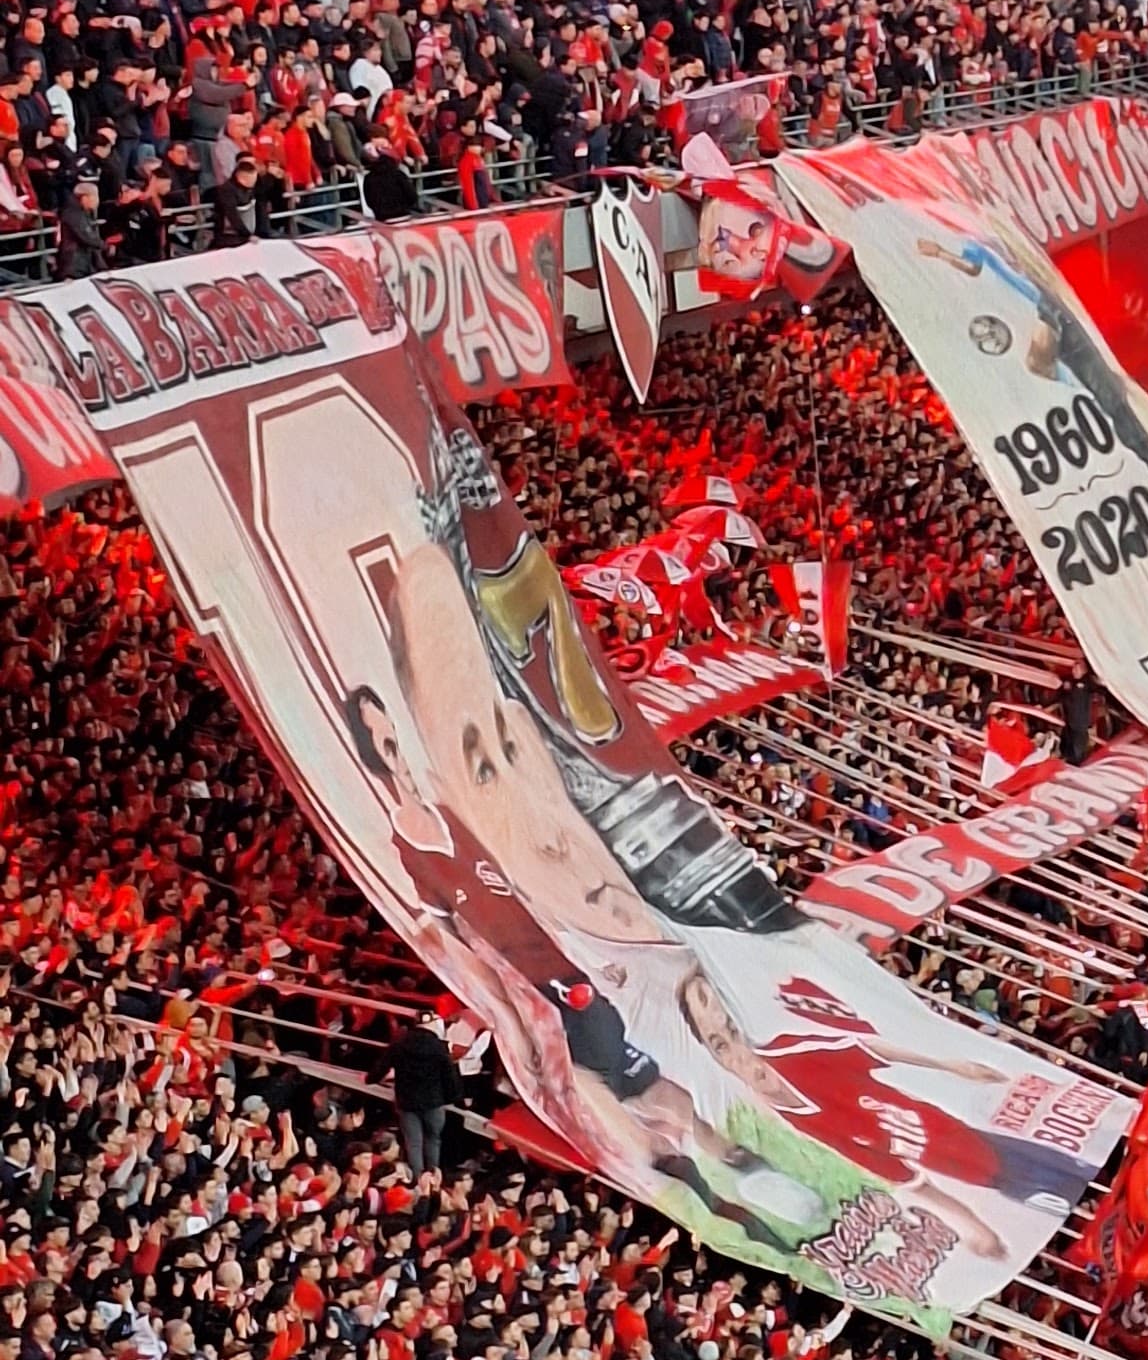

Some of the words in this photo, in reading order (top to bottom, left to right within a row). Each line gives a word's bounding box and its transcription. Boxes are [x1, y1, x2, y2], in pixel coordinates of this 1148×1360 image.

[30, 295, 153, 411] LA
[96, 272, 326, 387] BARRA
[994, 393, 1116, 497] 1960
[828, 835, 995, 917] DE
